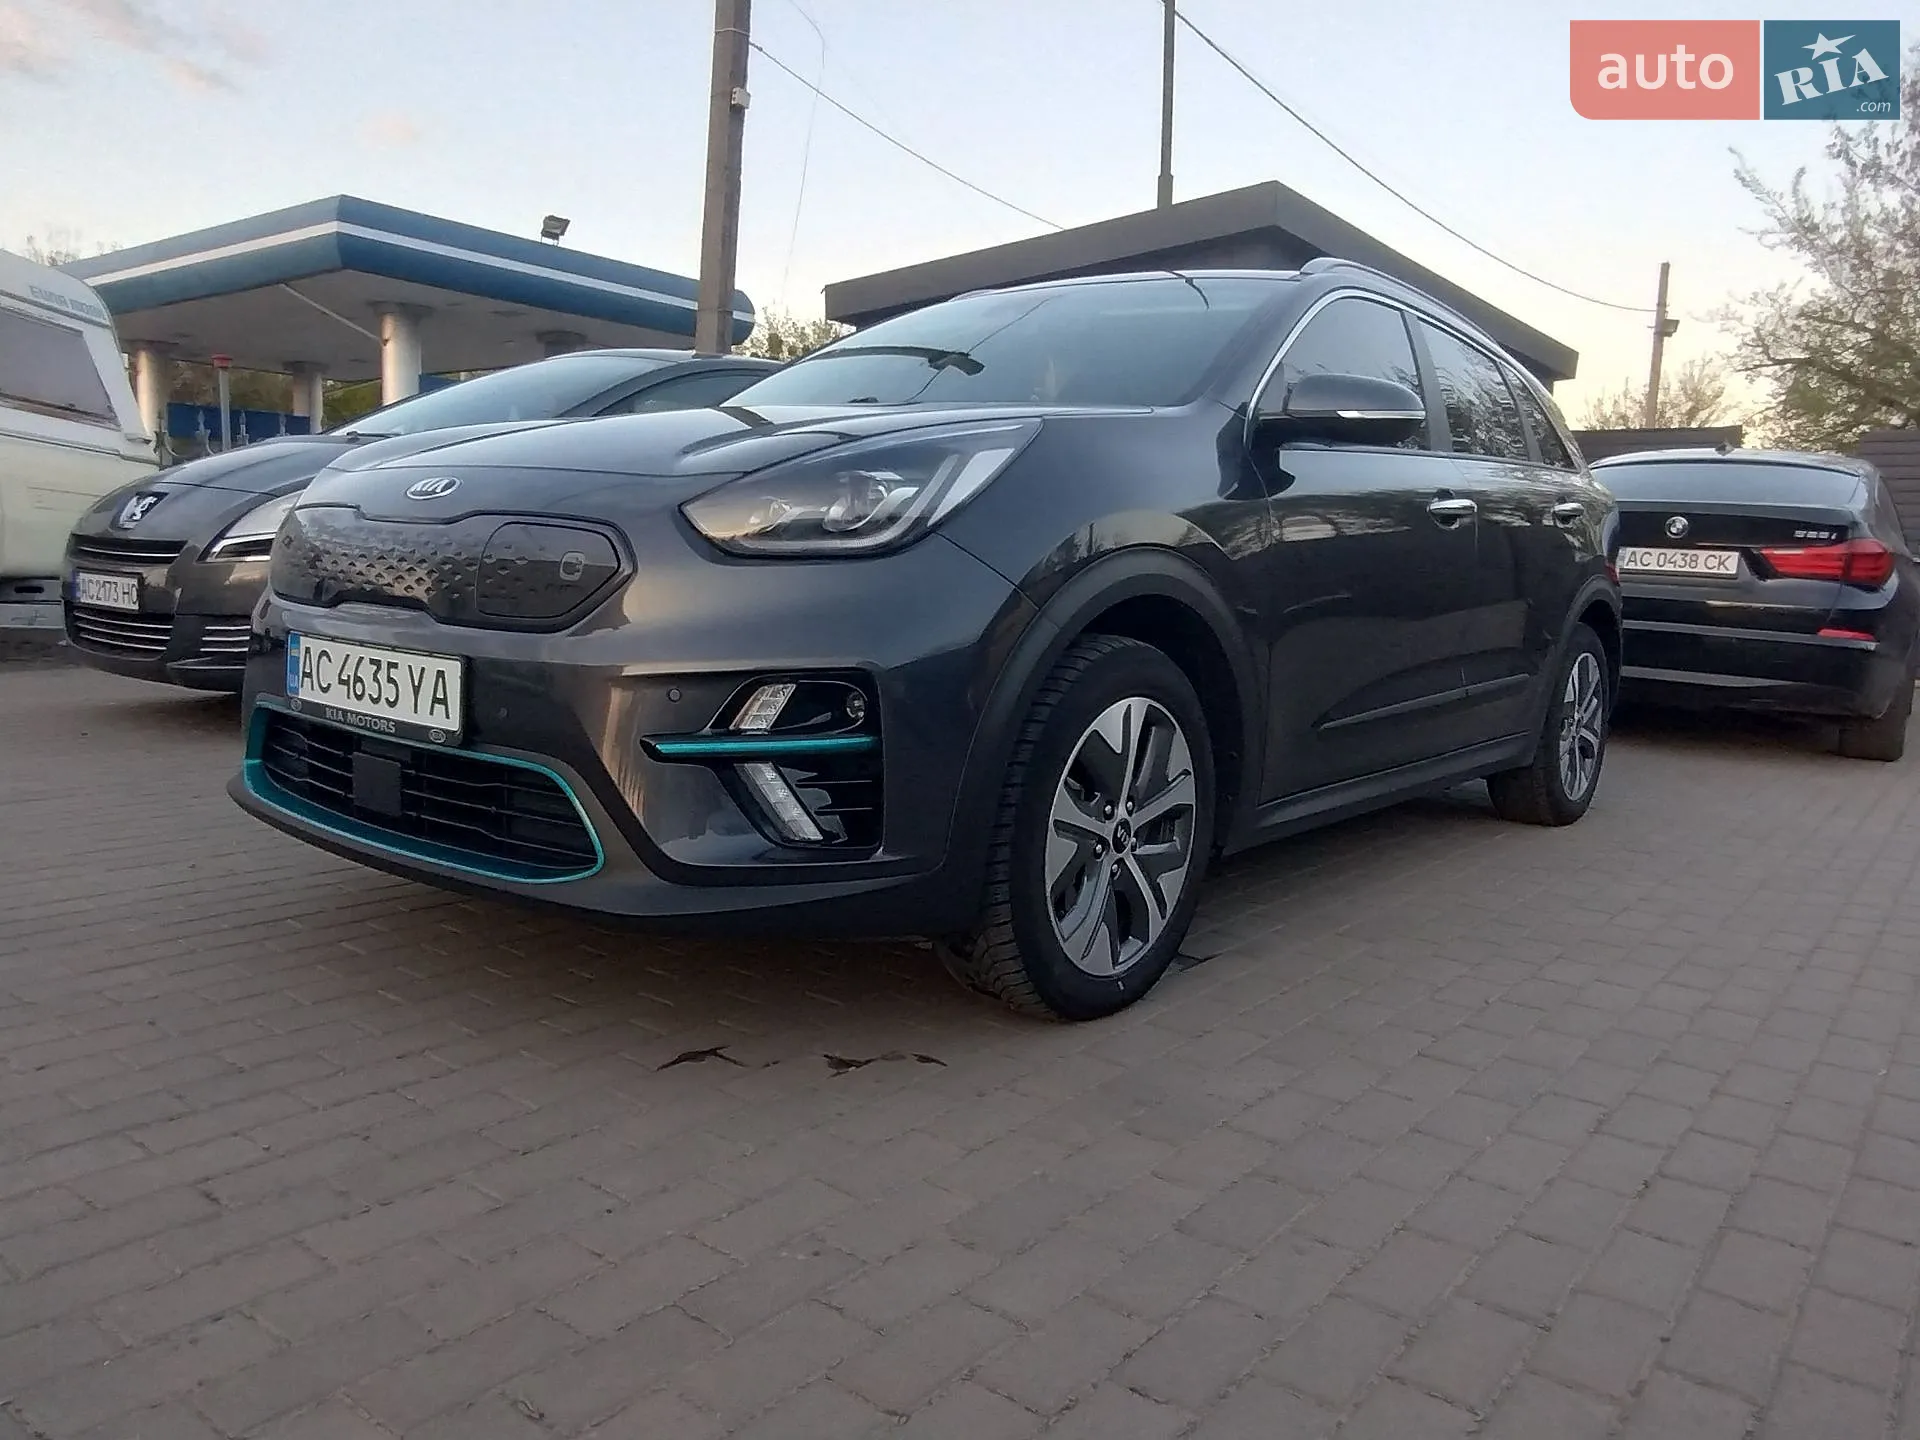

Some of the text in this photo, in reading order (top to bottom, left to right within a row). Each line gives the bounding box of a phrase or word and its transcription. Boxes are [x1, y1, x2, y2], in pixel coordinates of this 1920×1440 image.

[1625, 550, 1731, 572] AC 0438 CK
[301, 646, 450, 720] AC 4635 YA
[325, 707, 396, 733] KIA MOTORS
